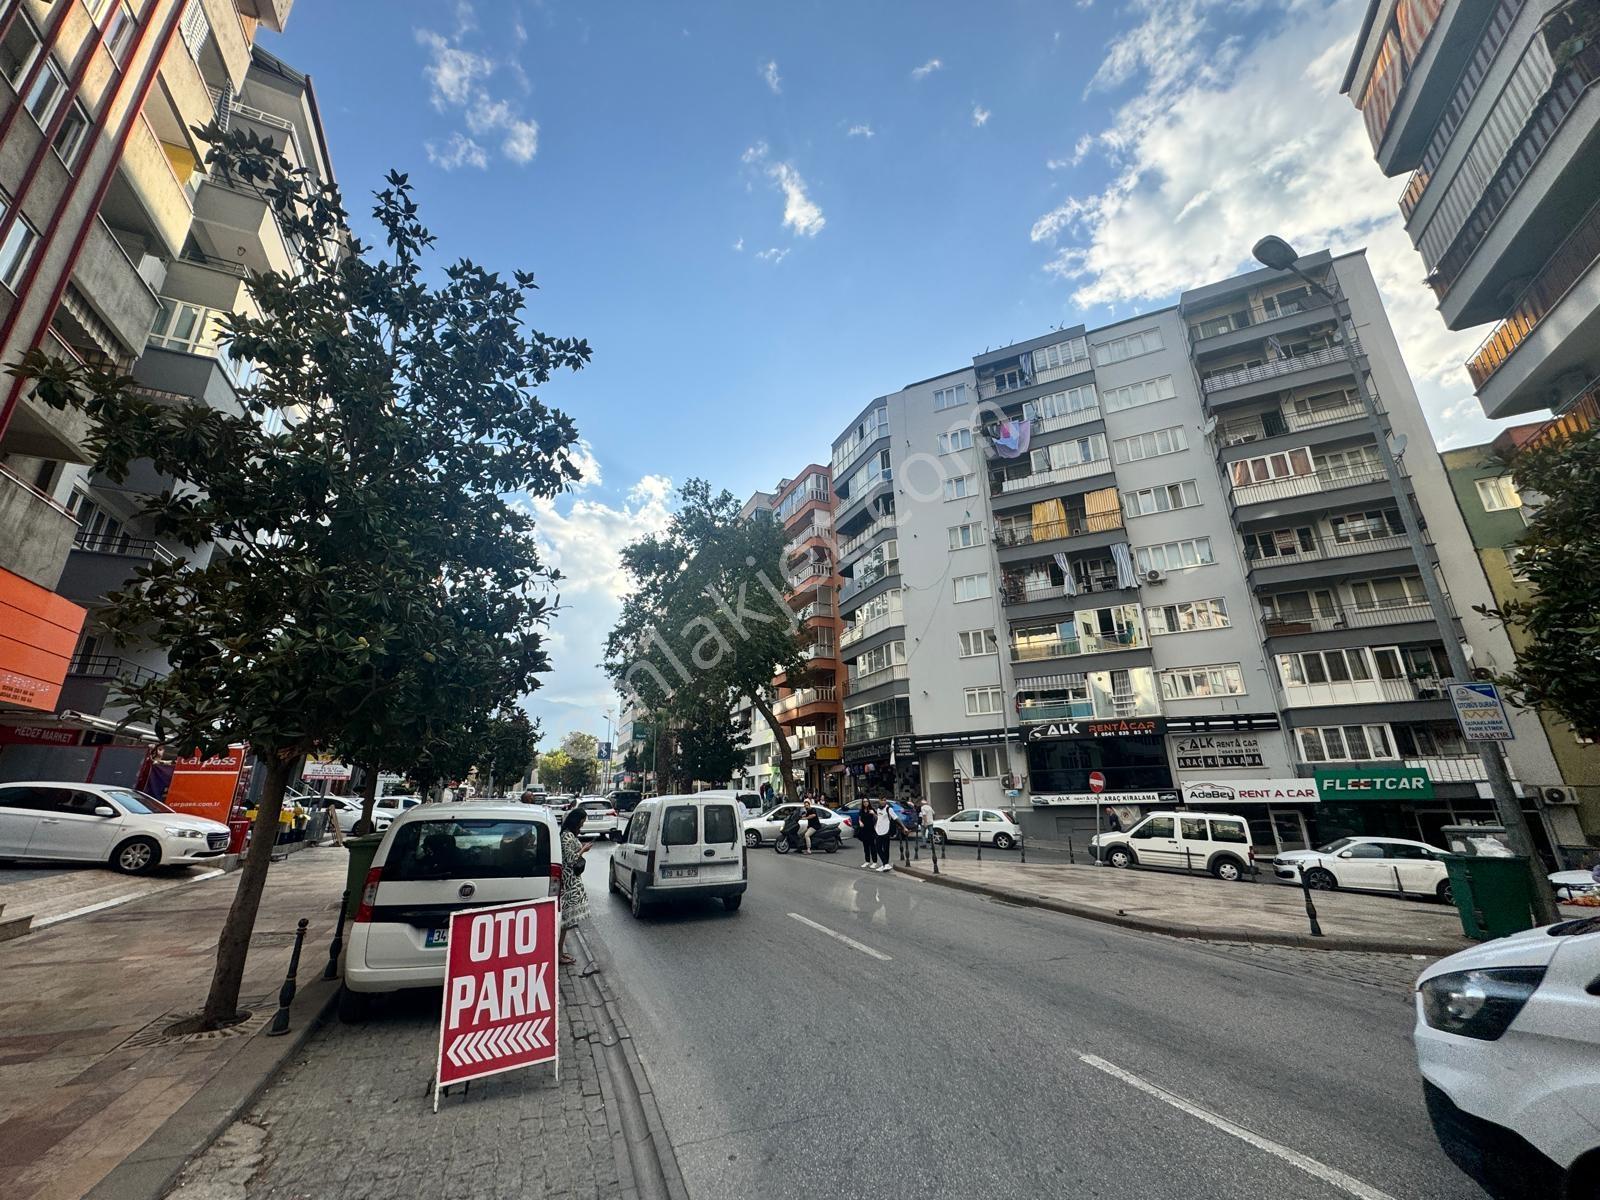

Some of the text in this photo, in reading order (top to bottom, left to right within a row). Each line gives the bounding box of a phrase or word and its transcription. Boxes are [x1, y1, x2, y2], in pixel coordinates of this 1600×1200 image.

[15, 726, 73, 744] HEDEF MARKET
[1047, 723, 1080, 736] ALK
[1190, 737, 1214, 749] ALK
[1322, 777, 1425, 790] FLEETCAR
[1190, 790, 1235, 800] AdaBey
[1239, 789, 1270, 798] RENT
[1287, 789, 1315, 798] CAR
[434, 930, 447, 942] 34
[470, 908, 537, 962] OTO
[449, 962, 551, 1030] PARK
